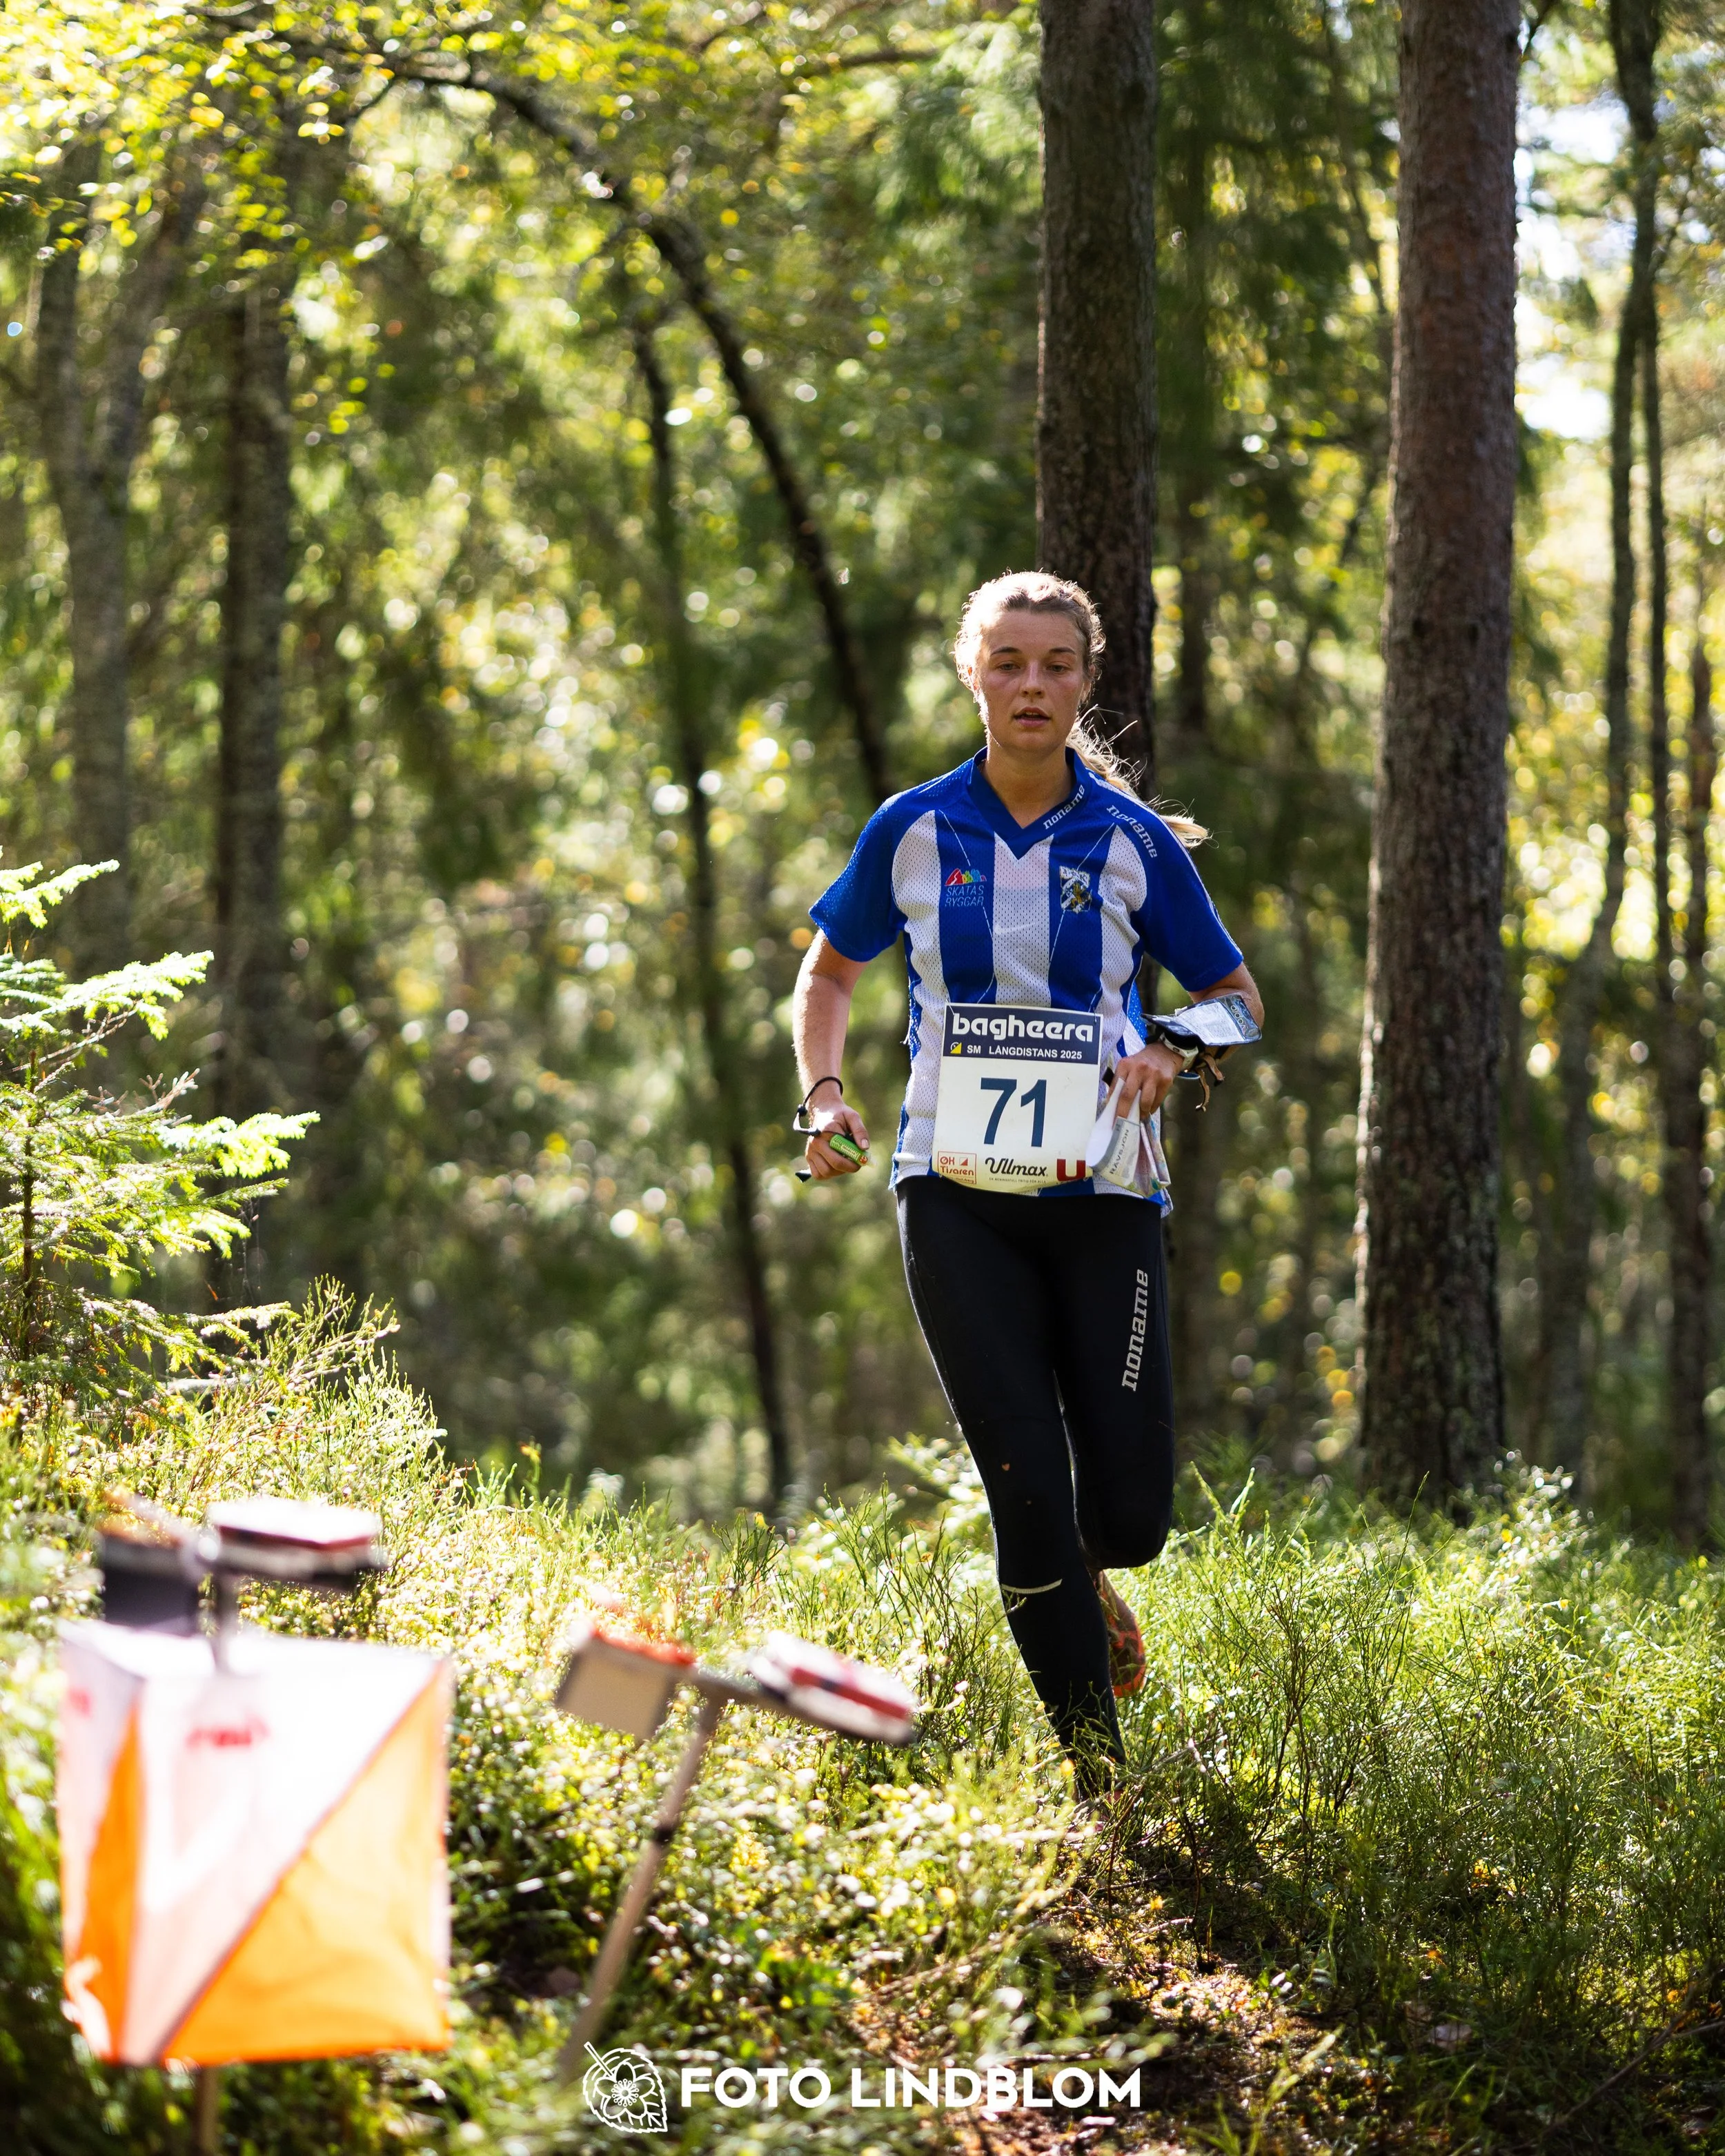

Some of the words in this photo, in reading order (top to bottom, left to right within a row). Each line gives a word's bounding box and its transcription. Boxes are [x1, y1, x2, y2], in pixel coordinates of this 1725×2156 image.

[1043, 784, 1085, 829] noname
[1106, 804, 1157, 858] noname
[945, 896, 984, 907] RYGGAR
[952, 1013, 1093, 1042] bagheera
[967, 1045, 981, 1054] SM
[989, 1045, 1058, 1058] LÅNGDISTANS
[1061, 1049, 1083, 1059] 2025
[980, 1077, 1047, 1147] 71
[940, 1165, 974, 1176] Tisaren
[985, 1157, 1047, 1176] Ullmax
[1121, 1269, 1148, 1392] noname
